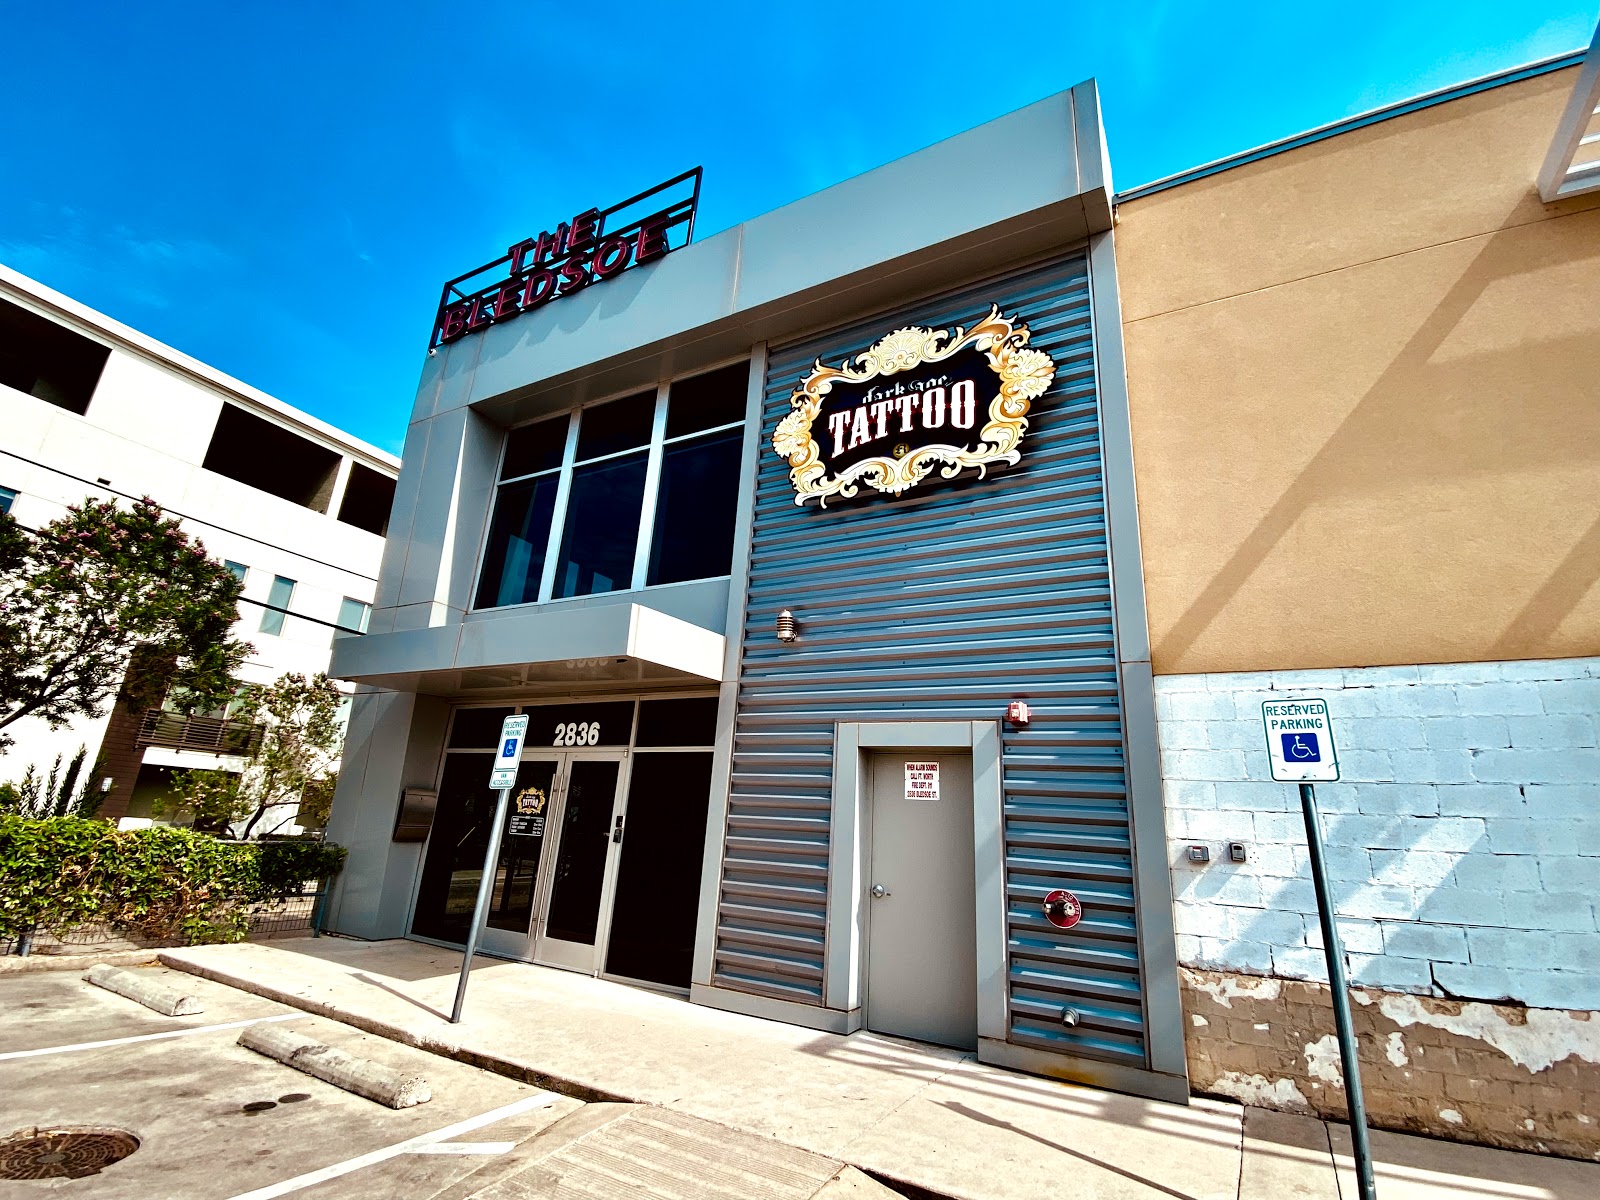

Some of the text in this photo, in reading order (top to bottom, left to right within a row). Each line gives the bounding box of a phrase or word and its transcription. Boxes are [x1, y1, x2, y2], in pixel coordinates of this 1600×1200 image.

[508, 207, 601, 276] THE
[440, 214, 671, 345] BLEDSOE
[828, 379, 976, 459] TATTOO
[1265, 704, 1325, 717] RESERVED
[504, 721, 527, 729] RESERVED
[553, 722, 600, 746] 2836
[1271, 718, 1323, 730] PARKING
